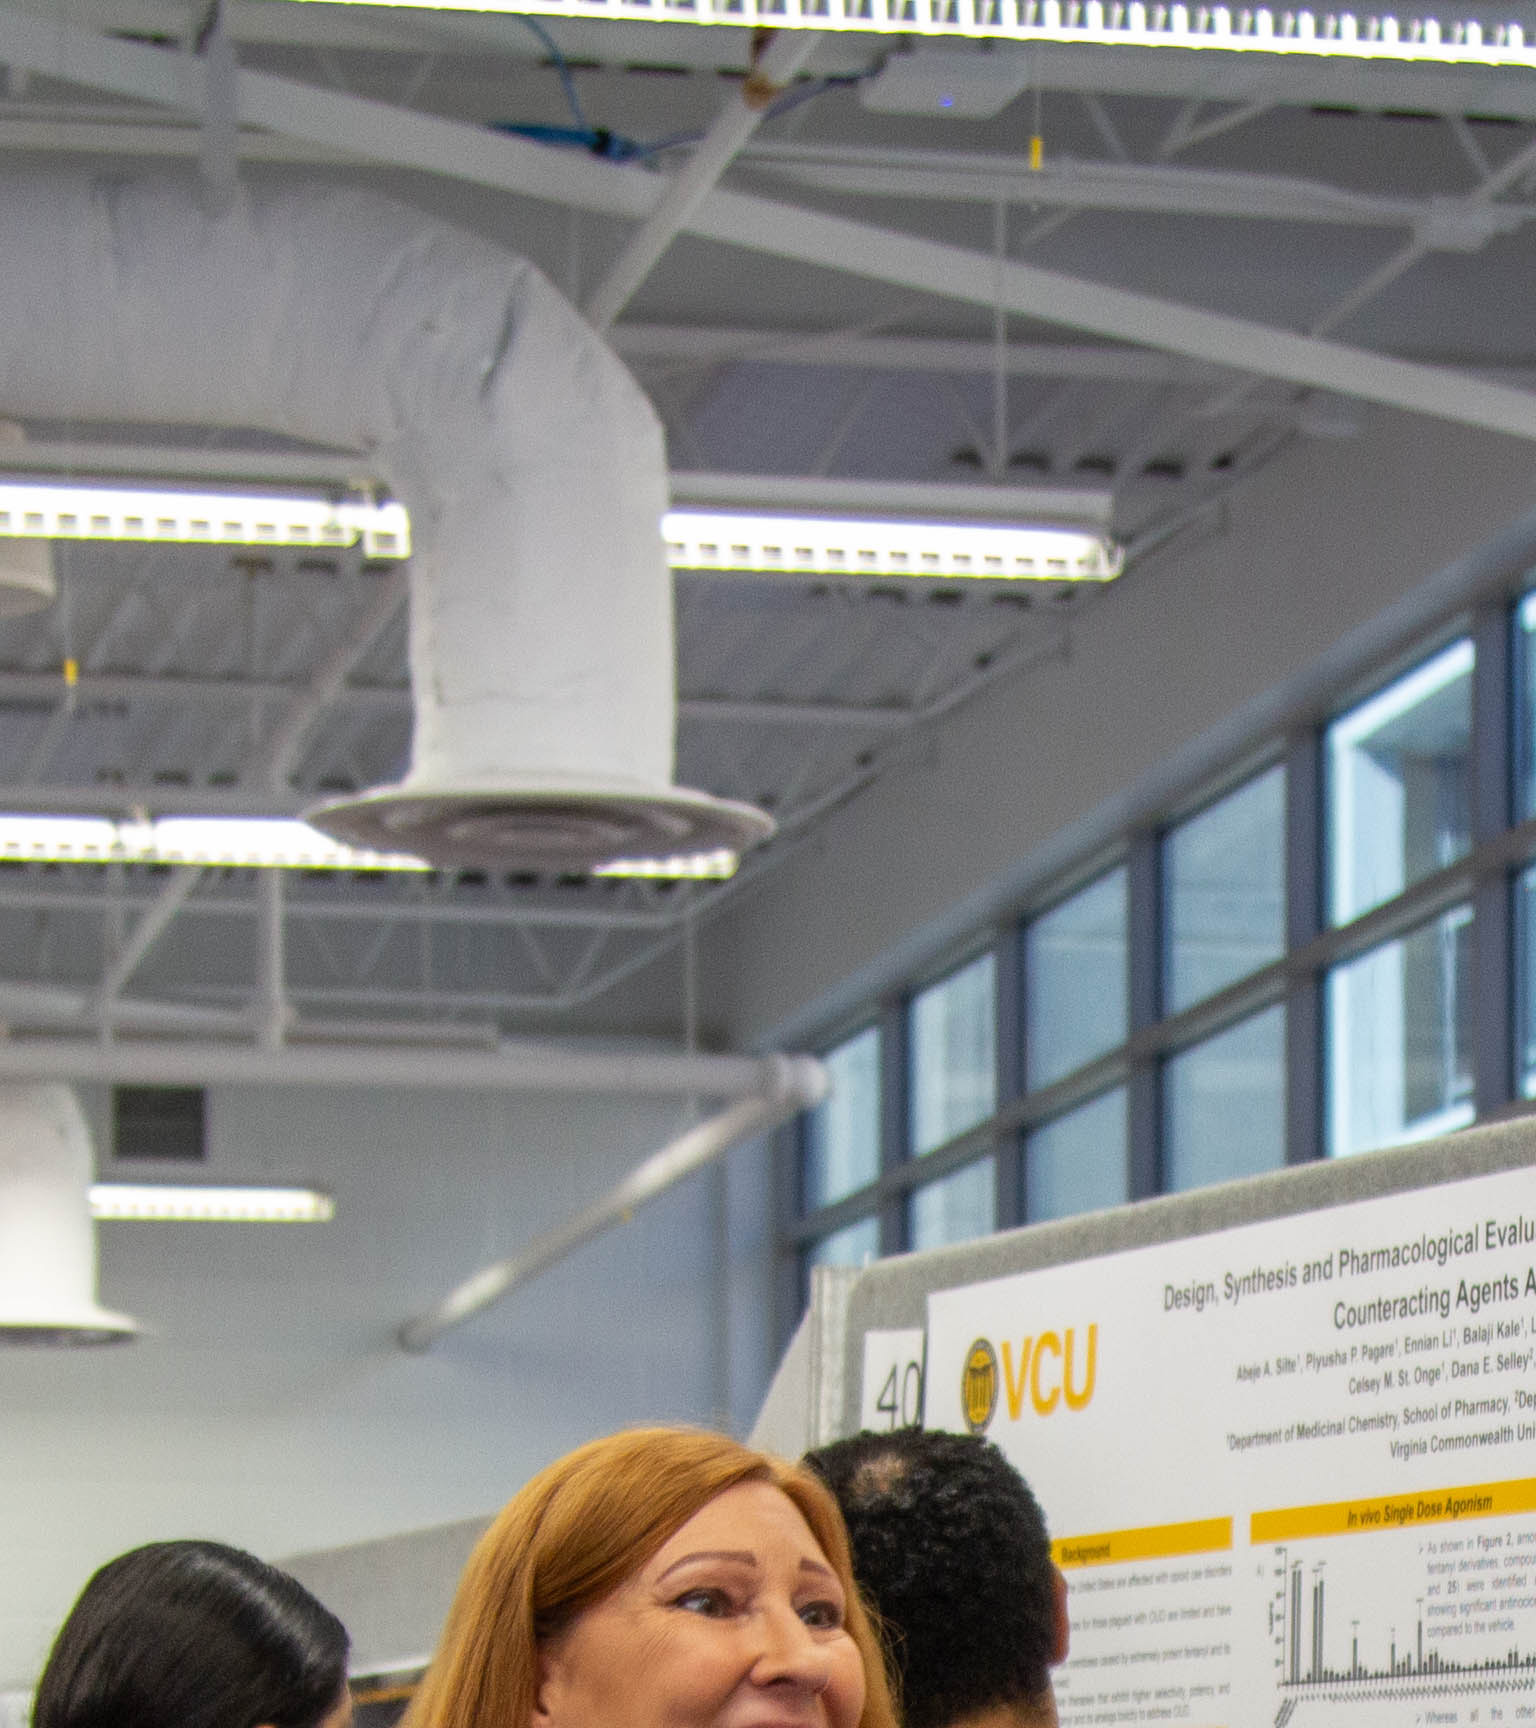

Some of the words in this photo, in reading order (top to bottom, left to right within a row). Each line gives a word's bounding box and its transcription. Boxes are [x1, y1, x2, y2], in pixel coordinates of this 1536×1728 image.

[1164, 1279, 1218, 1312] Design,
[1224, 1260, 1297, 1306] Synthesis
[1302, 1252, 1333, 1285] and
[1339, 1223, 1478, 1277] Pharmacological
[1333, 1285, 1450, 1330] Counteracting
[1455, 1273, 1519, 1314] Agents
[1463, 1323, 1493, 1345] Balaji
[999, 1323, 1099, 1422] VCU
[1451, 1359, 1479, 1378] Dana
[875, 1360, 921, 1430] 40
[1284, 1423, 1294, 1443] of
[1296, 1417, 1345, 1440] Medicinal
[1403, 1402, 1438, 1425] School
[1440, 1400, 1451, 1420] of
[1389, 1437, 1427, 1461] Virginia
[1430, 1424, 1514, 1453] Commonwealth
[1347, 1507, 1358, 1528] In
[1383, 1503, 1414, 1525] Single
[1416, 1499, 1442, 1519] Dose
[1445, 1492, 1492, 1519] Agonism
